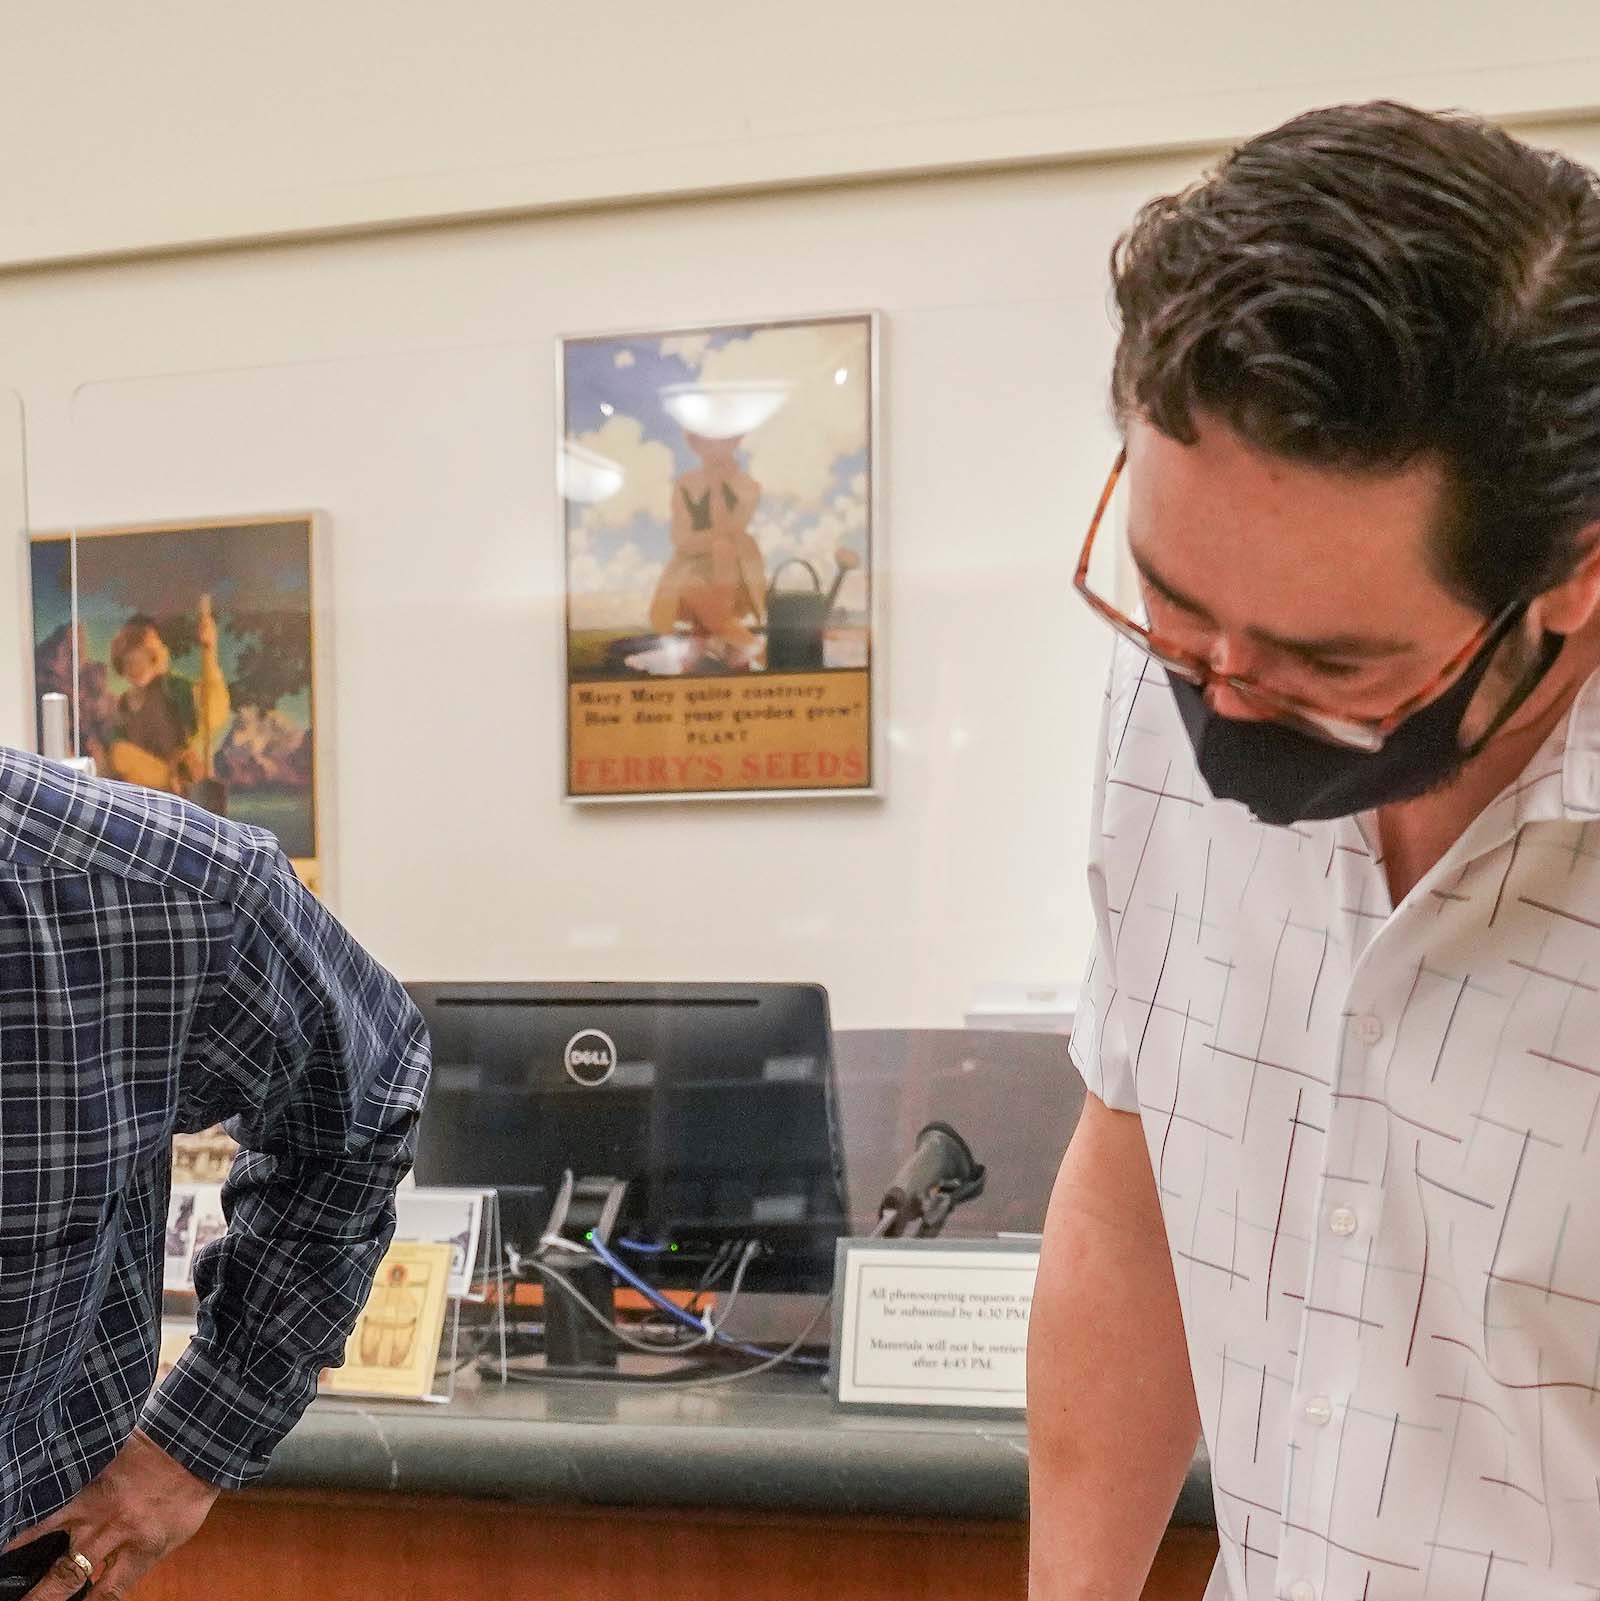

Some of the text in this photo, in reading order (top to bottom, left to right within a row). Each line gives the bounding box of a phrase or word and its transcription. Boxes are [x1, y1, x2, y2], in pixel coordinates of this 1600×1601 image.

[686, 730, 748, 744] PLANT
[574, 750, 865, 785] FERRY'S SEEDS
[570, 1050, 611, 1066] DELL
[869, 1287, 886, 1298] All
[883, 1305, 896, 1316] be
[900, 1305, 956, 1317] submitted
[869, 1337, 923, 1351] Materials
[926, 1340, 946, 1351] will
